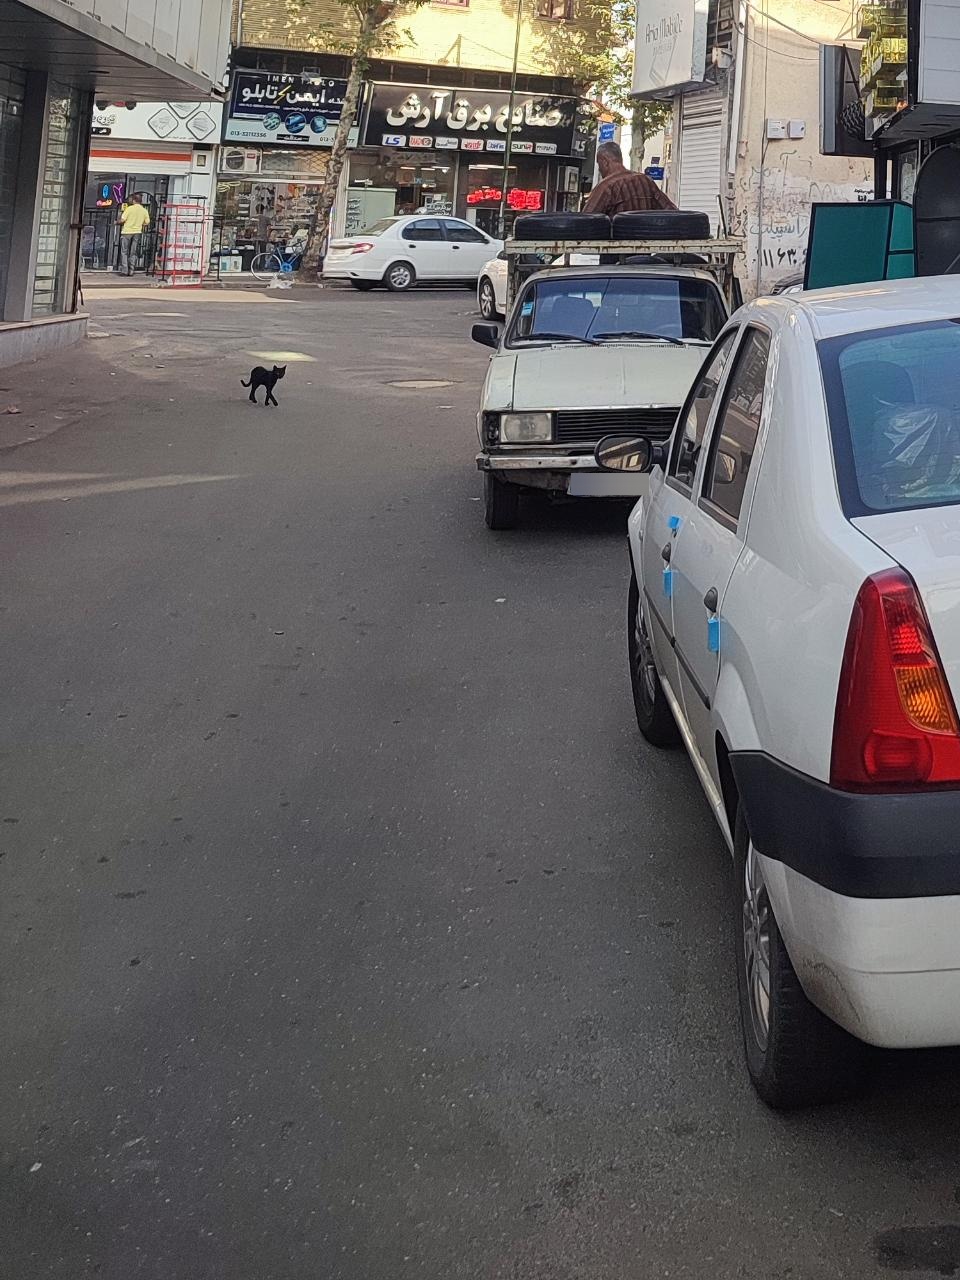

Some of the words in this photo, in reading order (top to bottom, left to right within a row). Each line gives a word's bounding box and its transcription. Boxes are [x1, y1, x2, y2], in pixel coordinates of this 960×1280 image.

[242, 84, 279, 103] تابلو
[286, 89, 326, 107] ایمن
[386, 91, 450, 129] آرش
[446, 98, 492, 131] برق
[494, 101, 562, 133] صنایع
